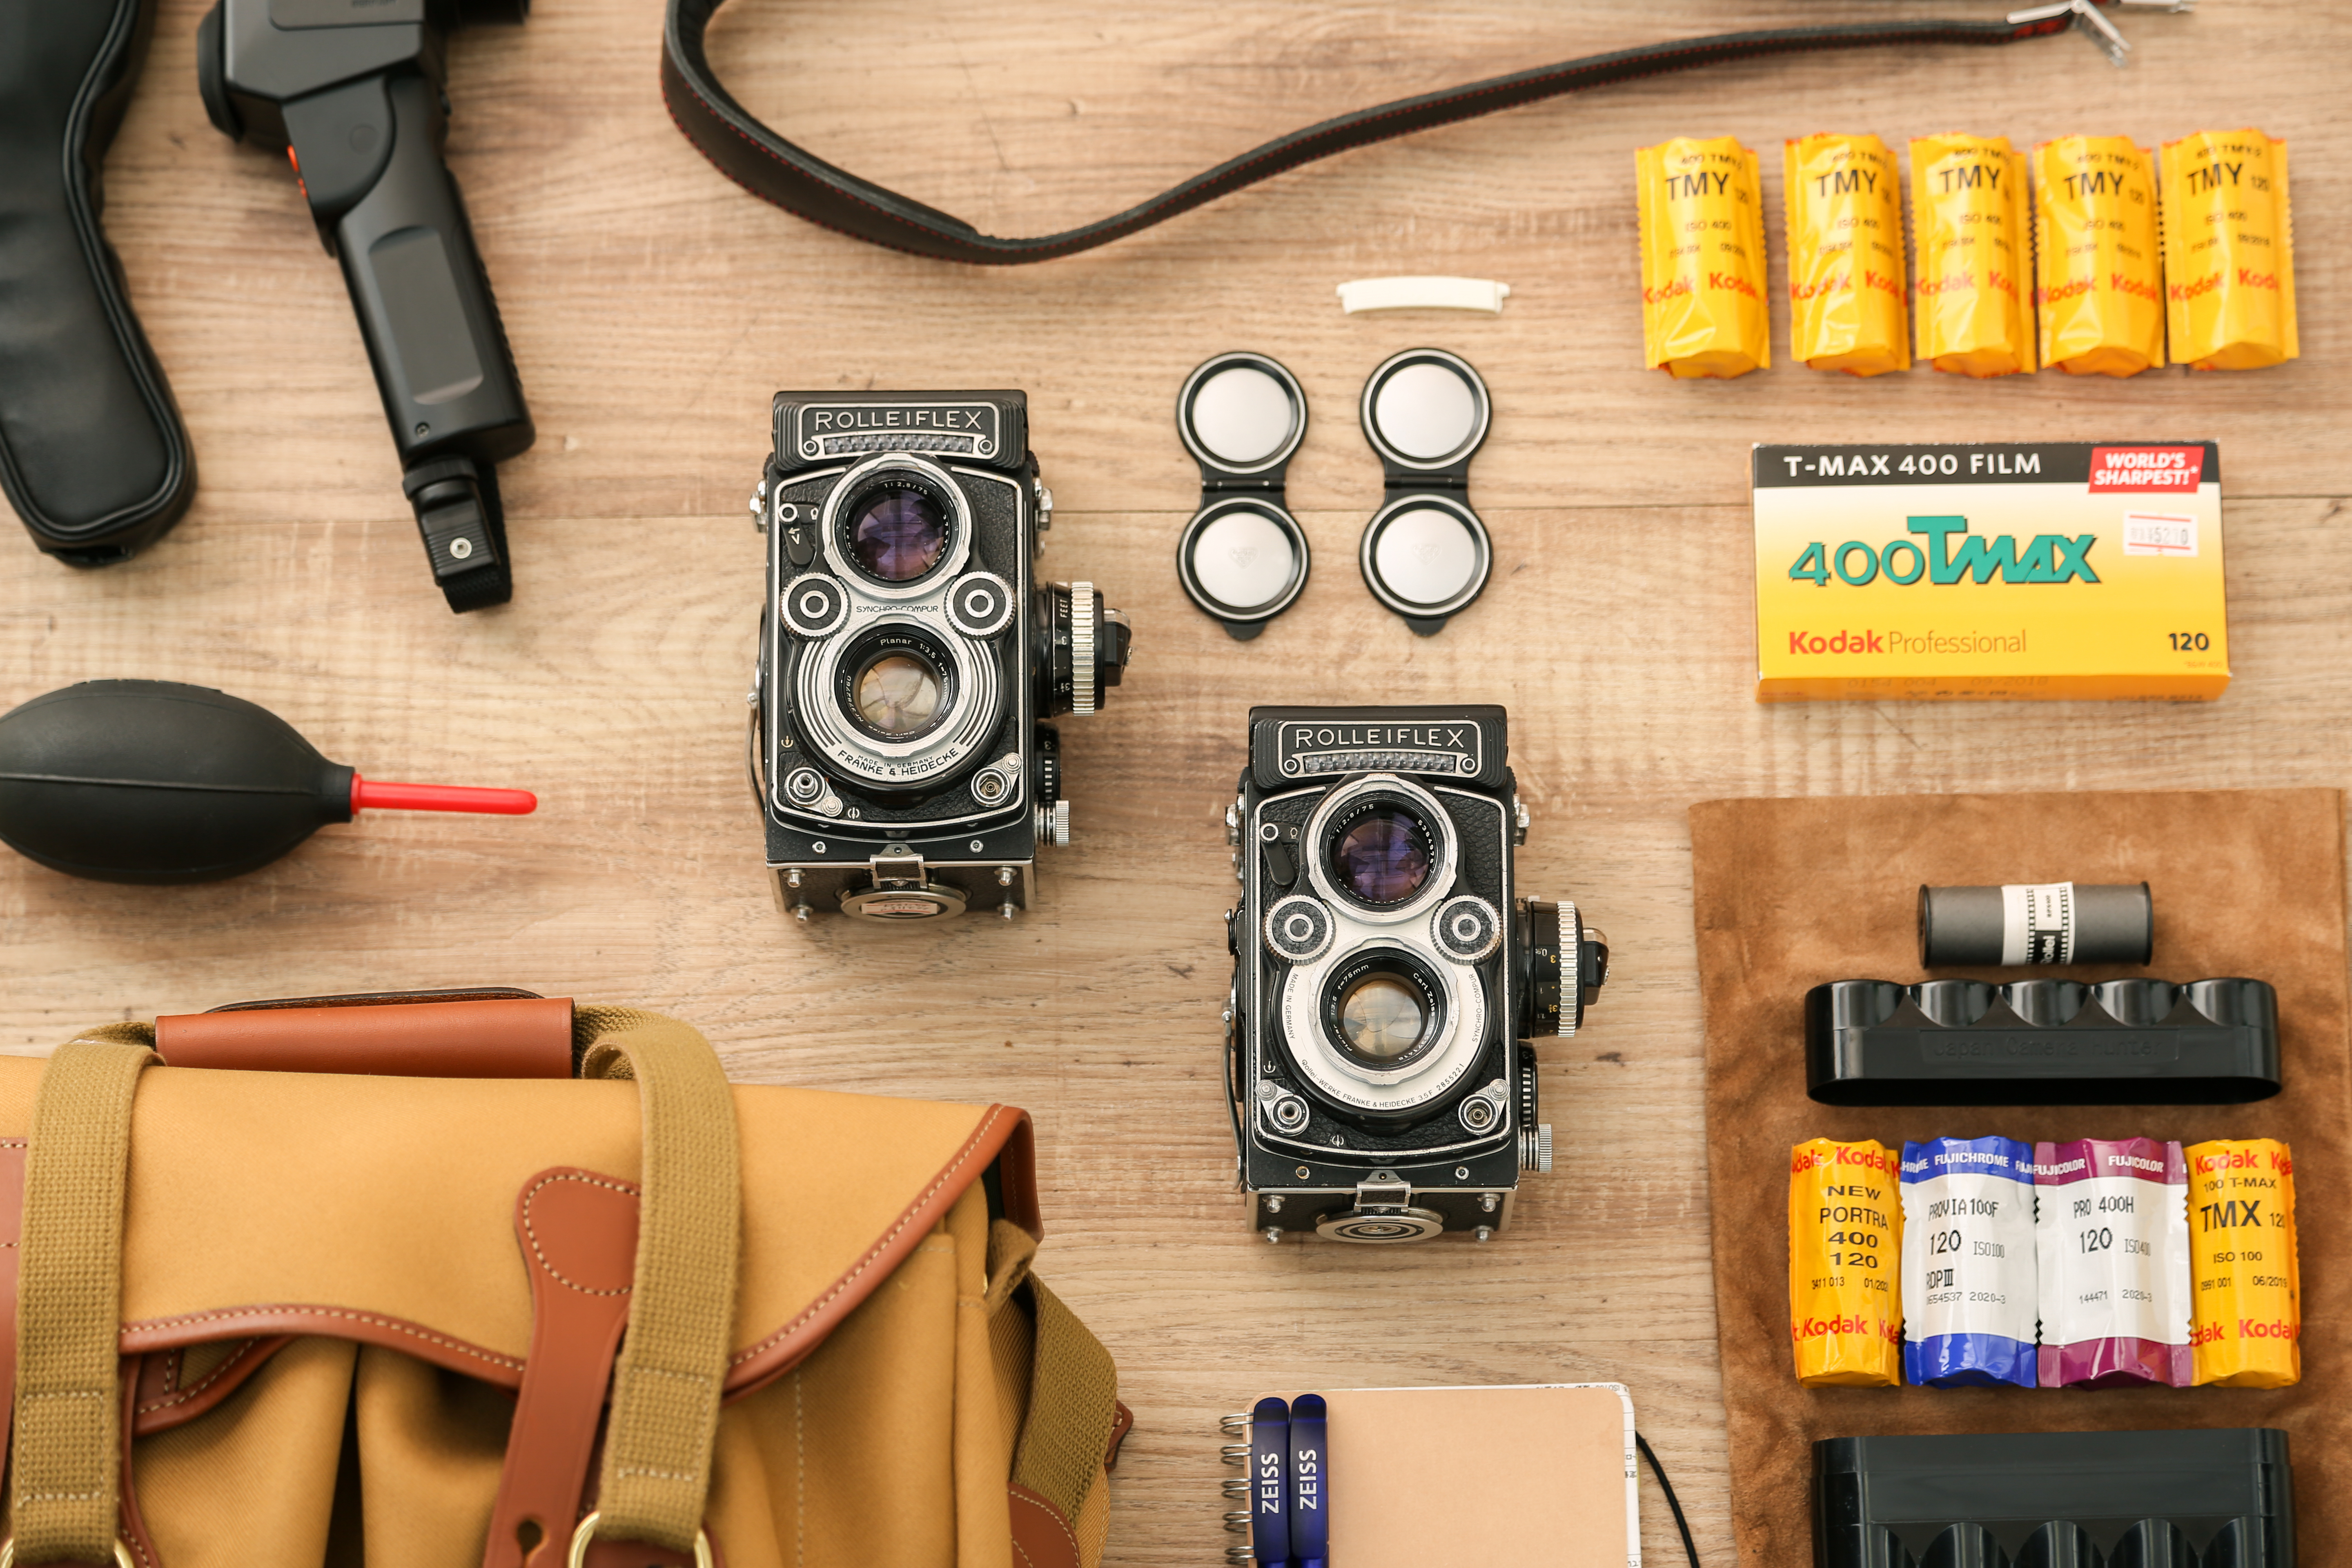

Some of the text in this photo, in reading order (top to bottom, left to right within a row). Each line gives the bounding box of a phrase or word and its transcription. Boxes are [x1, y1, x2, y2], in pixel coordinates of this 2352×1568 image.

[1666, 172, 1729, 200] TMY
[1816, 169, 1877, 197] TMY
[1940, 165, 2000, 193] TMY
[2064, 172, 2124, 201] TMY
[2187, 163, 2243, 195] TMY
[1643, 275, 1696, 305] Kodak
[1791, 272, 1851, 301] Kodak
[1915, 271, 1975, 296] Kodak
[2039, 275, 2098, 305] Kodak
[2171, 272, 2225, 302] Kodak
[815, 411, 982, 431] ROLLEIFLEX
[1784, 453, 2042, 478] T-MAX 400 FILM
[2105, 452, 2186, 469] WORLD'S
[1059, 599, 1068, 618] FEET
[1788, 629, 2027, 655] Kodak Professional
[2169, 633, 2209, 651] 120
[1296, 728, 1464, 748] ROLLEIFLEX
[837, 750, 884, 775] FRANKE
[901, 748, 959, 776] HEIDECKE
[858, 755, 878, 766] MADE
[897, 755, 933, 768] GERMANY
[1287, 973, 1298, 993] MADE
[1413, 973, 1429, 990] Carl
[1427, 991, 1435, 1017] Zeiss
[1468, 973, 1483, 1043] SYNCHRO-COMPUR
[1285, 1006, 1296, 1039] GERMANY
[1333, 1024, 1353, 1051] Planar
[1933, 1038, 1994, 1059] Japan
[2005, 1036, 2078, 1056] Camera
[1342, 1093, 1371, 1107] FRANKE
[1379, 1097, 1417, 1108] HEIDECKE
[1436, 1063, 1465, 1091] 2855221
[1934, 1152, 2009, 1167] FUJICHROME
[2033, 1158, 2086, 1176] FUJICOLOR
[2108, 1155, 2164, 1173] FUJICOLOR
[2195, 1149, 2260, 1176] Kodak
[1828, 1185, 1882, 1200] NEW
[2203, 1177, 2277, 1193] 100 T-MAX
[1820, 1207, 1889, 1230] PORTRA
[1929, 1198, 1999, 1221] PROVIA 100F
[2074, 1196, 2134, 1219] PRO 400H
[2200, 1200, 2262, 1233] TMX
[1828, 1232, 1878, 1248] 400
[1930, 1230, 1961, 1256] 120
[2080, 1227, 2112, 1254] 120
[1830, 1252, 1878, 1269] 120
[2213, 1252, 2263, 1263] ISO 100
[1829, 1276, 1845, 1287] 013
[1927, 1291, 2006, 1305] 654537 2020-3
[2122, 1288, 2153, 1303] 2020-3
[1803, 1314, 1869, 1338] Kodak
[2189, 1321, 2225, 1347] odak
[1261, 1453, 1279, 1514] ZEISS
[1298, 1449, 1317, 1510] ZEISS
